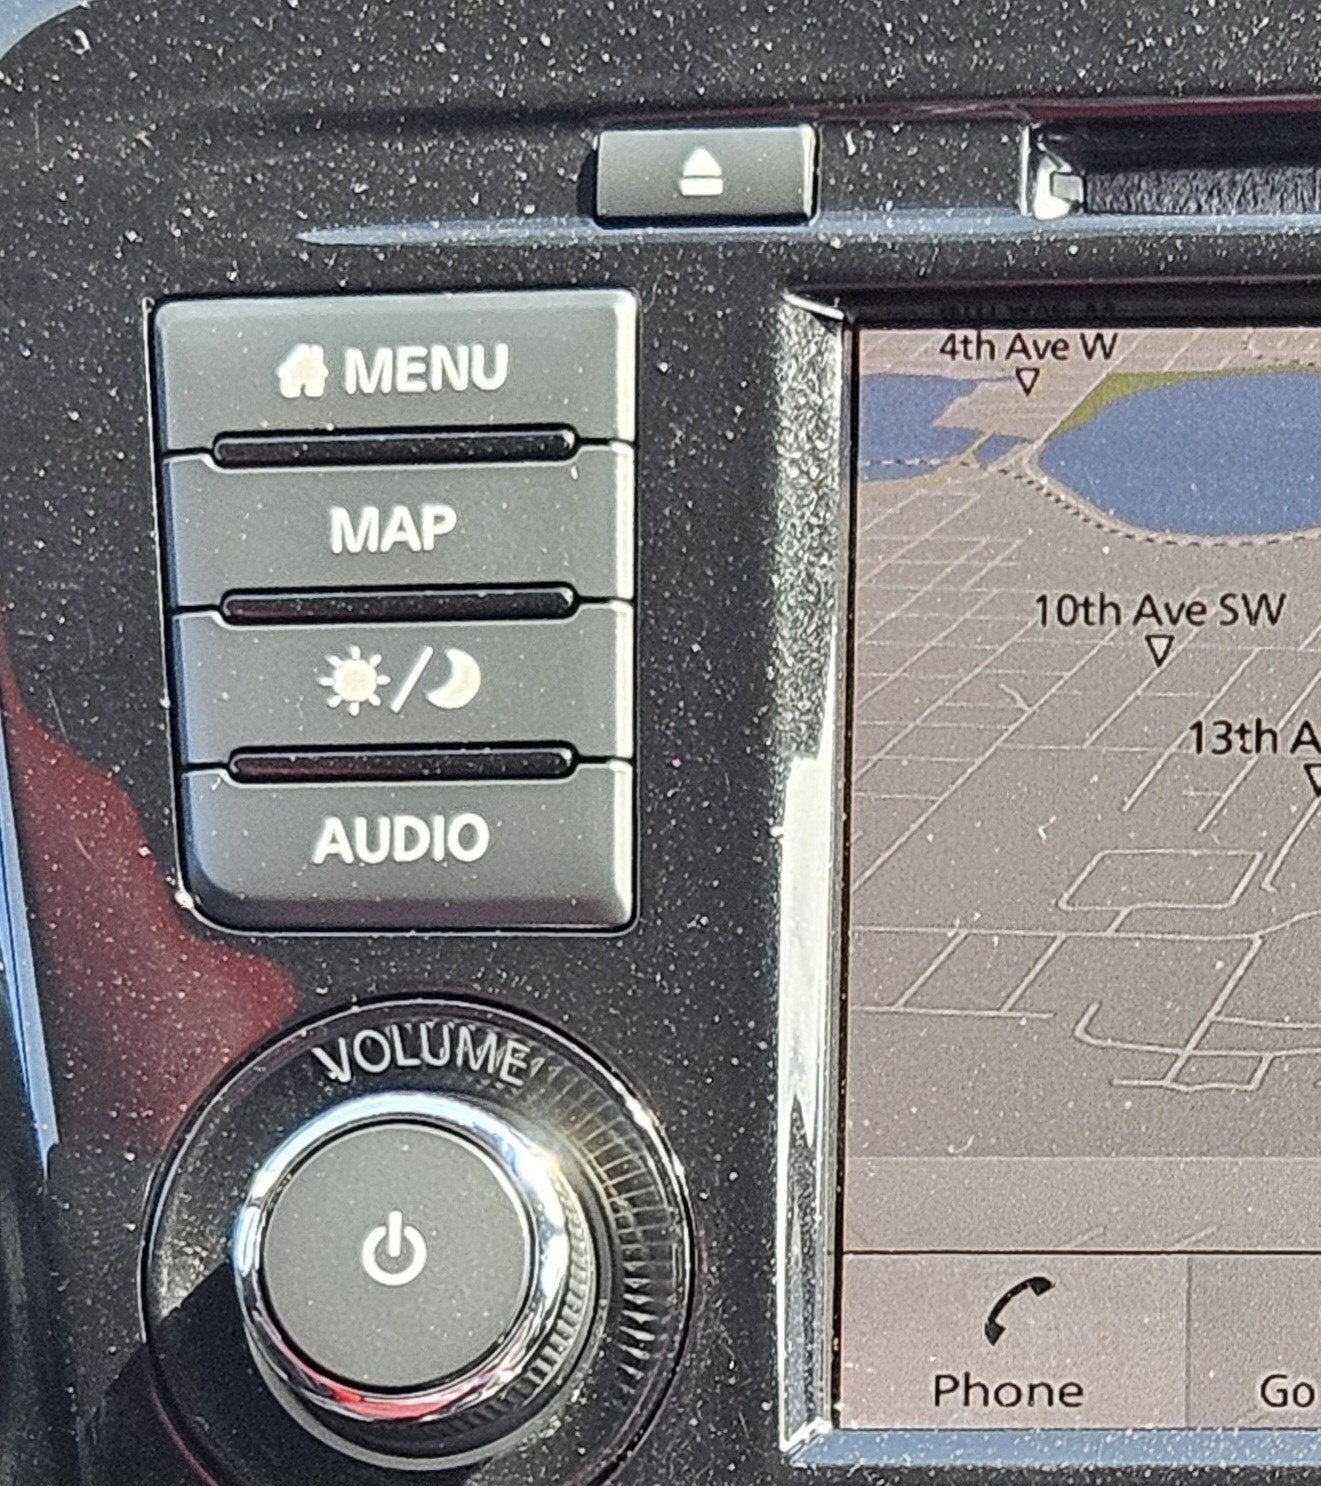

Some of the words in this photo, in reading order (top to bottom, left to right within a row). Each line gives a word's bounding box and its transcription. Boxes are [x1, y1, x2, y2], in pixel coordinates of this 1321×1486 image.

[939, 332, 996, 360] 4th
[1005, 332, 1069, 360] Ave
[1080, 332, 1118, 360] W
[344, 344, 509, 394] MENU
[330, 504, 457, 554] MAP
[1036, 593, 1121, 626] 10th
[1134, 593, 1211, 626] Ave
[1219, 593, 1286, 626] SW
[1189, 719, 1278, 755] 13th
[312, 813, 490, 865] AUDIO
[311, 1022, 531, 1087] VOLUME
[932, 1374, 1084, 1408] Phone
[1261, 1374, 1314, 1408] Go
